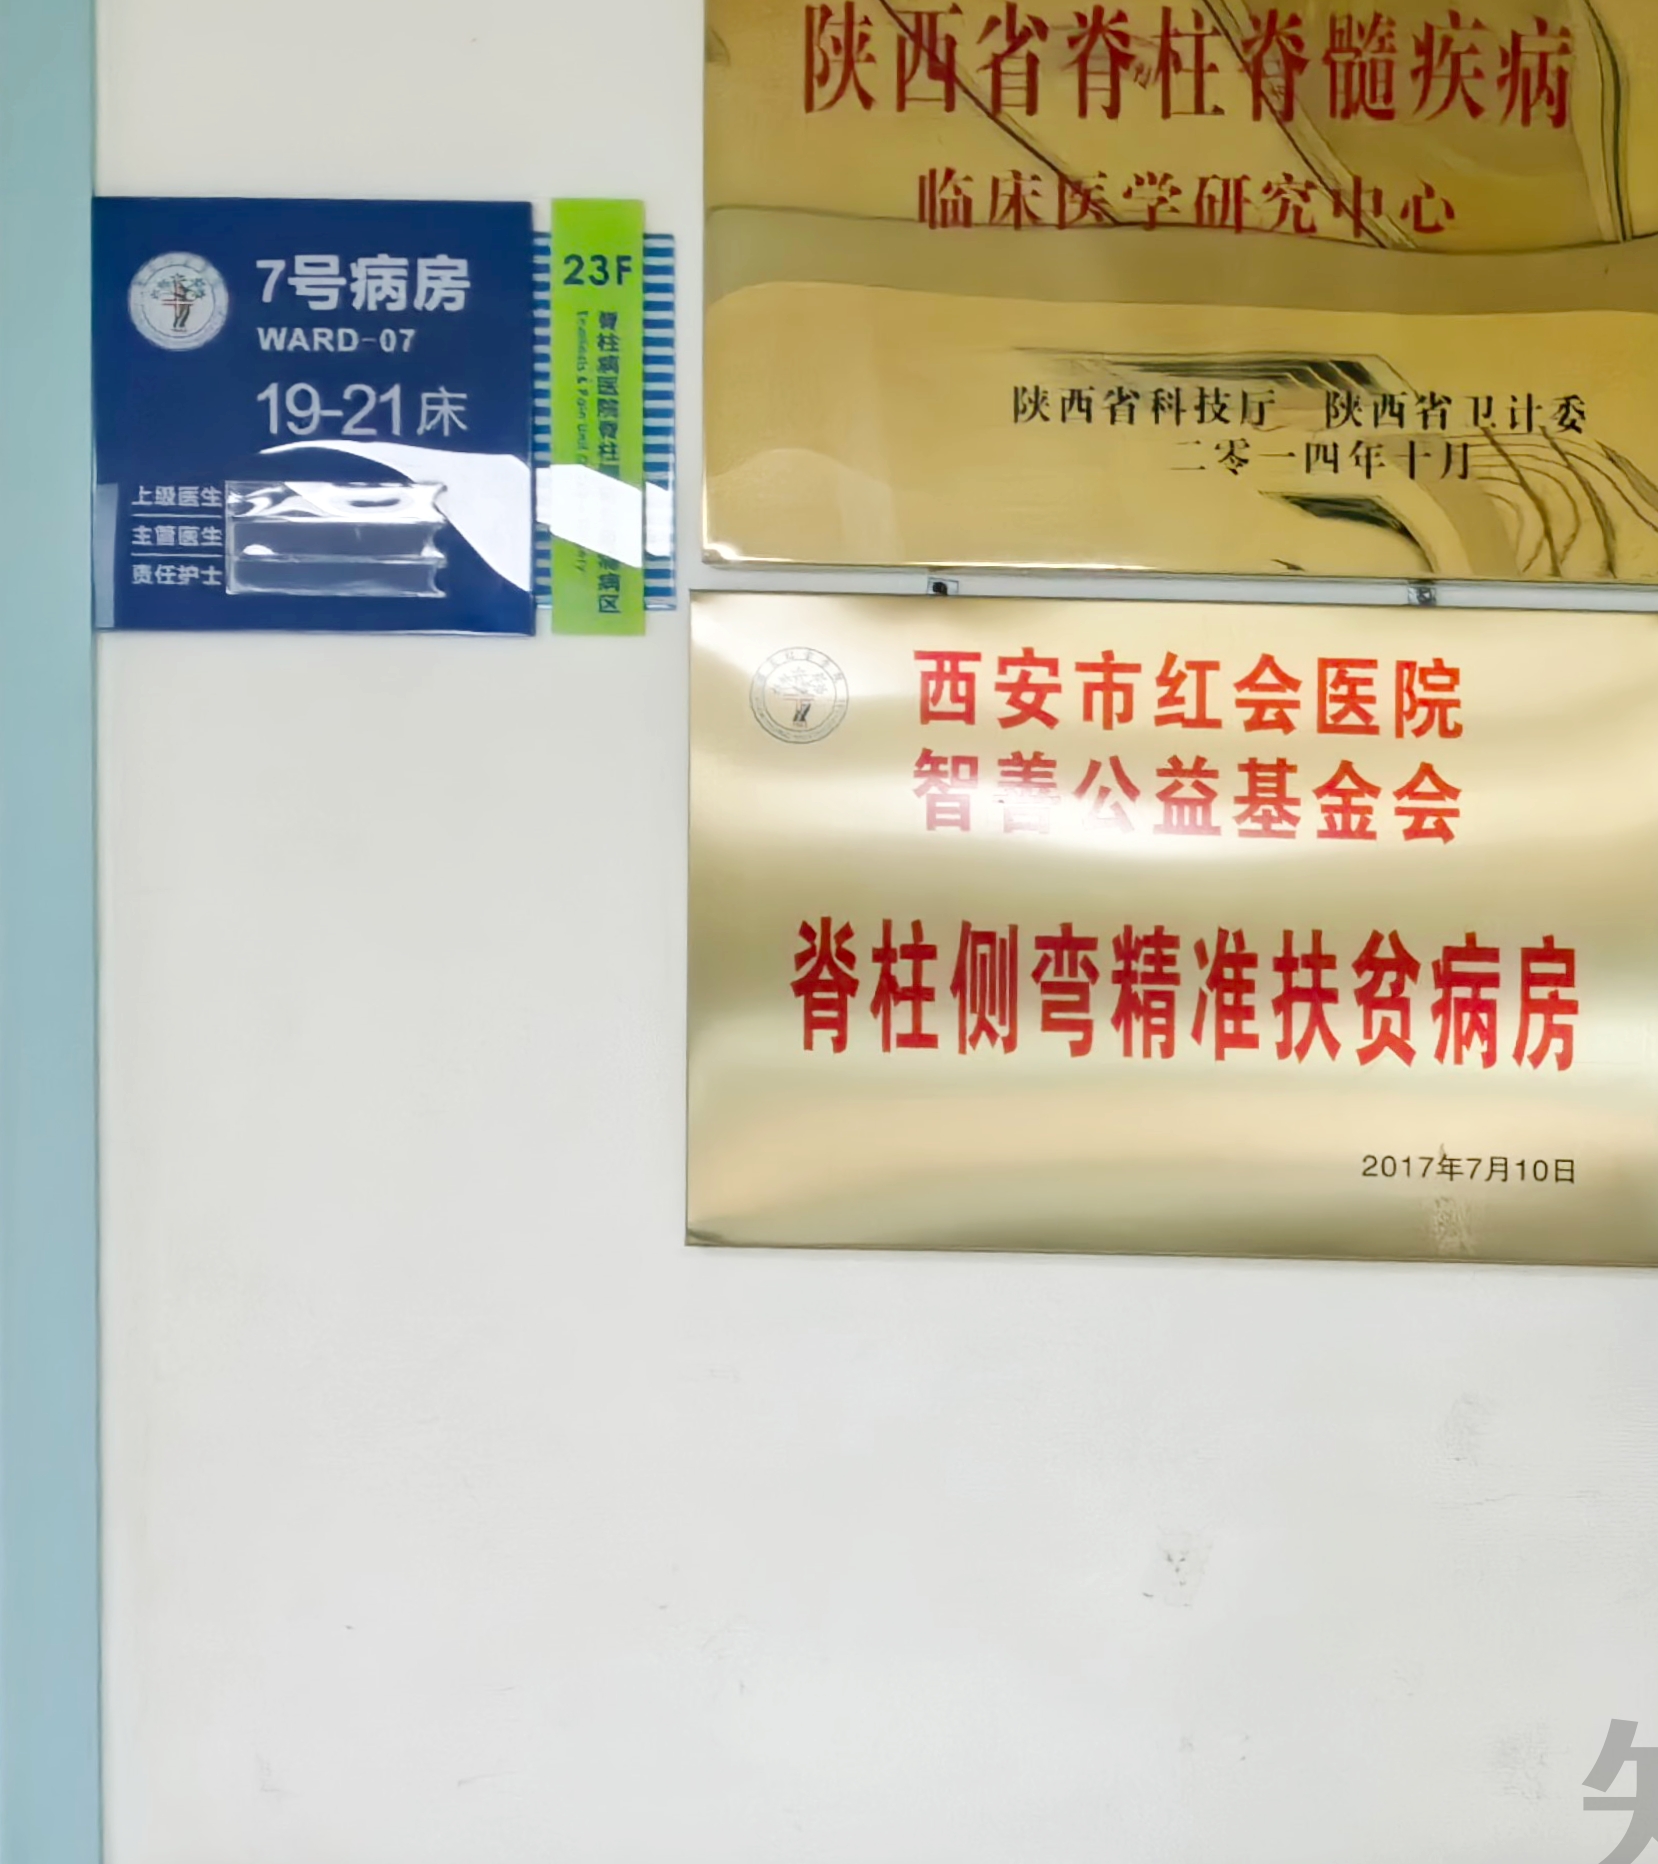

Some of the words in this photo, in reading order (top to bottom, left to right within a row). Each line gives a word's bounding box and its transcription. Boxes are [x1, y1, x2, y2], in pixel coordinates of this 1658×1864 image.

[803, 1, 1574, 129] 陕西省脊柱脊髓疾病
[917, 166, 1454, 238] 临床医学研究中心
[257, 253, 471, 312] 7号病房
[563, 254, 632, 286] 23F
[257, 327, 417, 354] WARD-07
[1012, 386, 1276, 426] 陕西省科技厅
[1325, 391, 1586, 433] 陕西省卫计委
[1171, 439, 1474, 480] 二零一四年十月
[131, 525, 223, 547] 主管医生
[131, 564, 223, 586] 责任护士
[913, 646, 1465, 740] 西安市红会医院
[913, 747, 1463, 843] 智善公益基金会
[791, 916, 1581, 1070] 脊柱侧弯精准扶贫病房
[1361, 1152, 1577, 1186] 2017年7月10日
